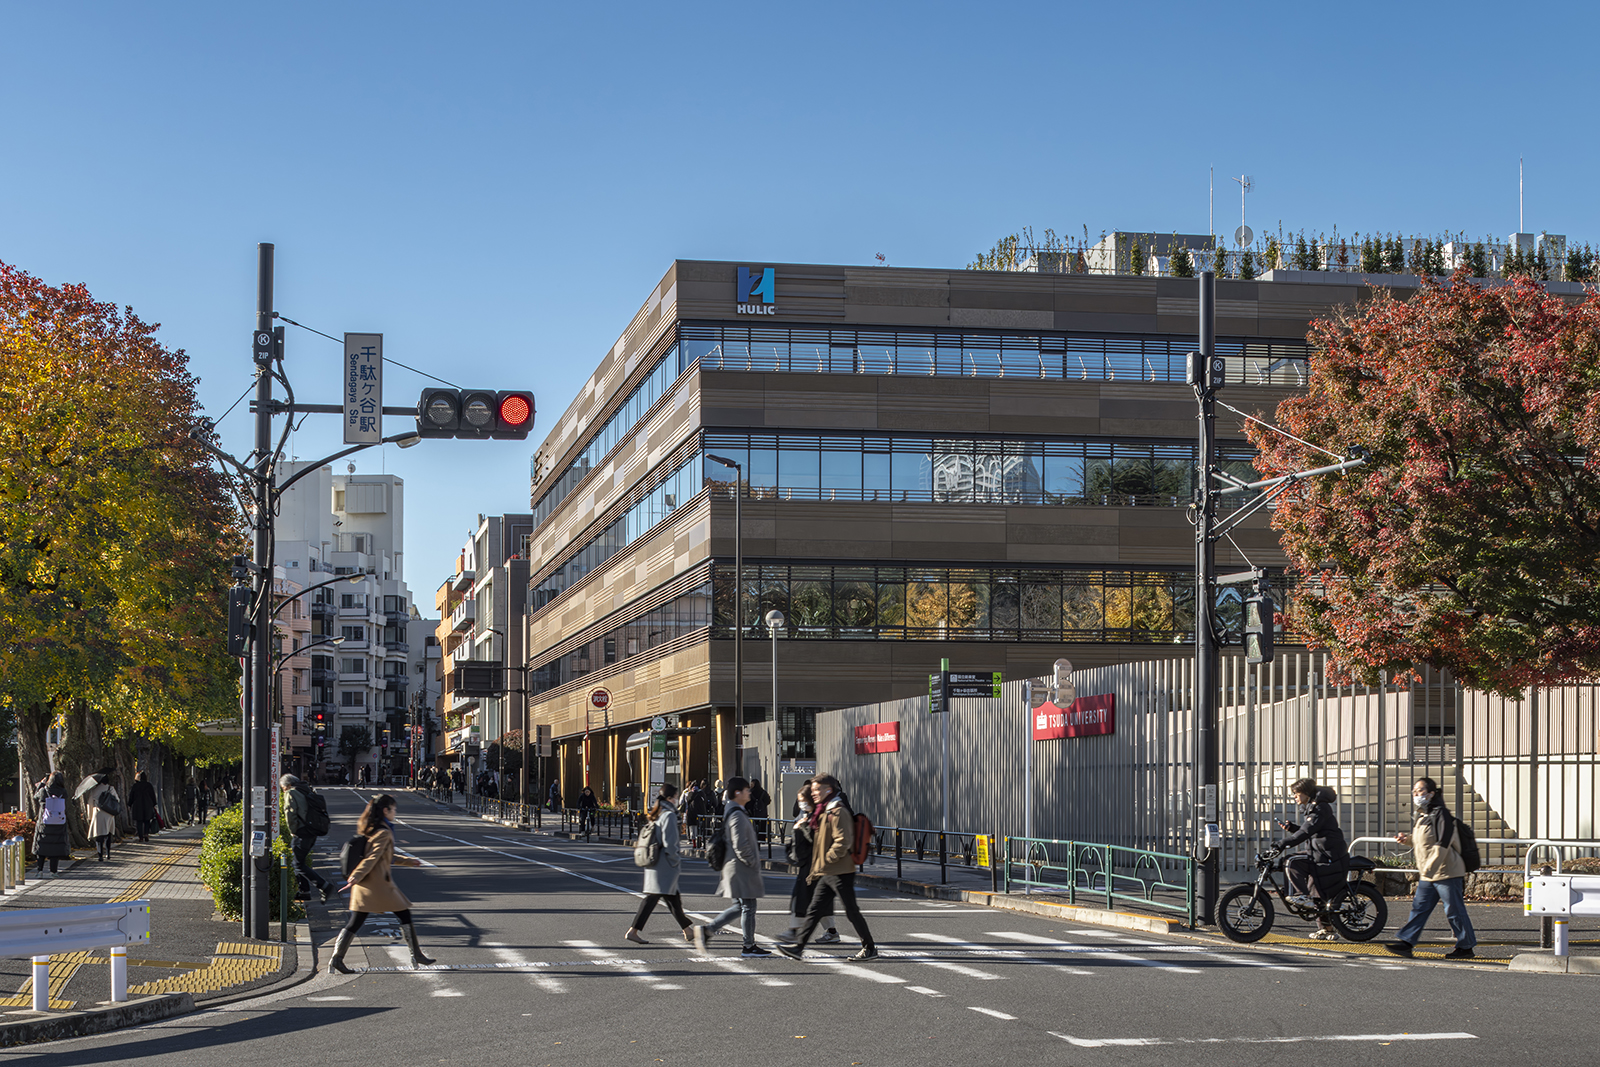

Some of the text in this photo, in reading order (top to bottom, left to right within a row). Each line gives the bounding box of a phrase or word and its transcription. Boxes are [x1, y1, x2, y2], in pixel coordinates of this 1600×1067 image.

[737, 304, 775, 315] HULIC
[348, 353, 359, 428] Sendagaya Sta.
[656, 718, 661, 726] 3
[1048, 708, 1108, 728] TSUDA UNIVERSITY
